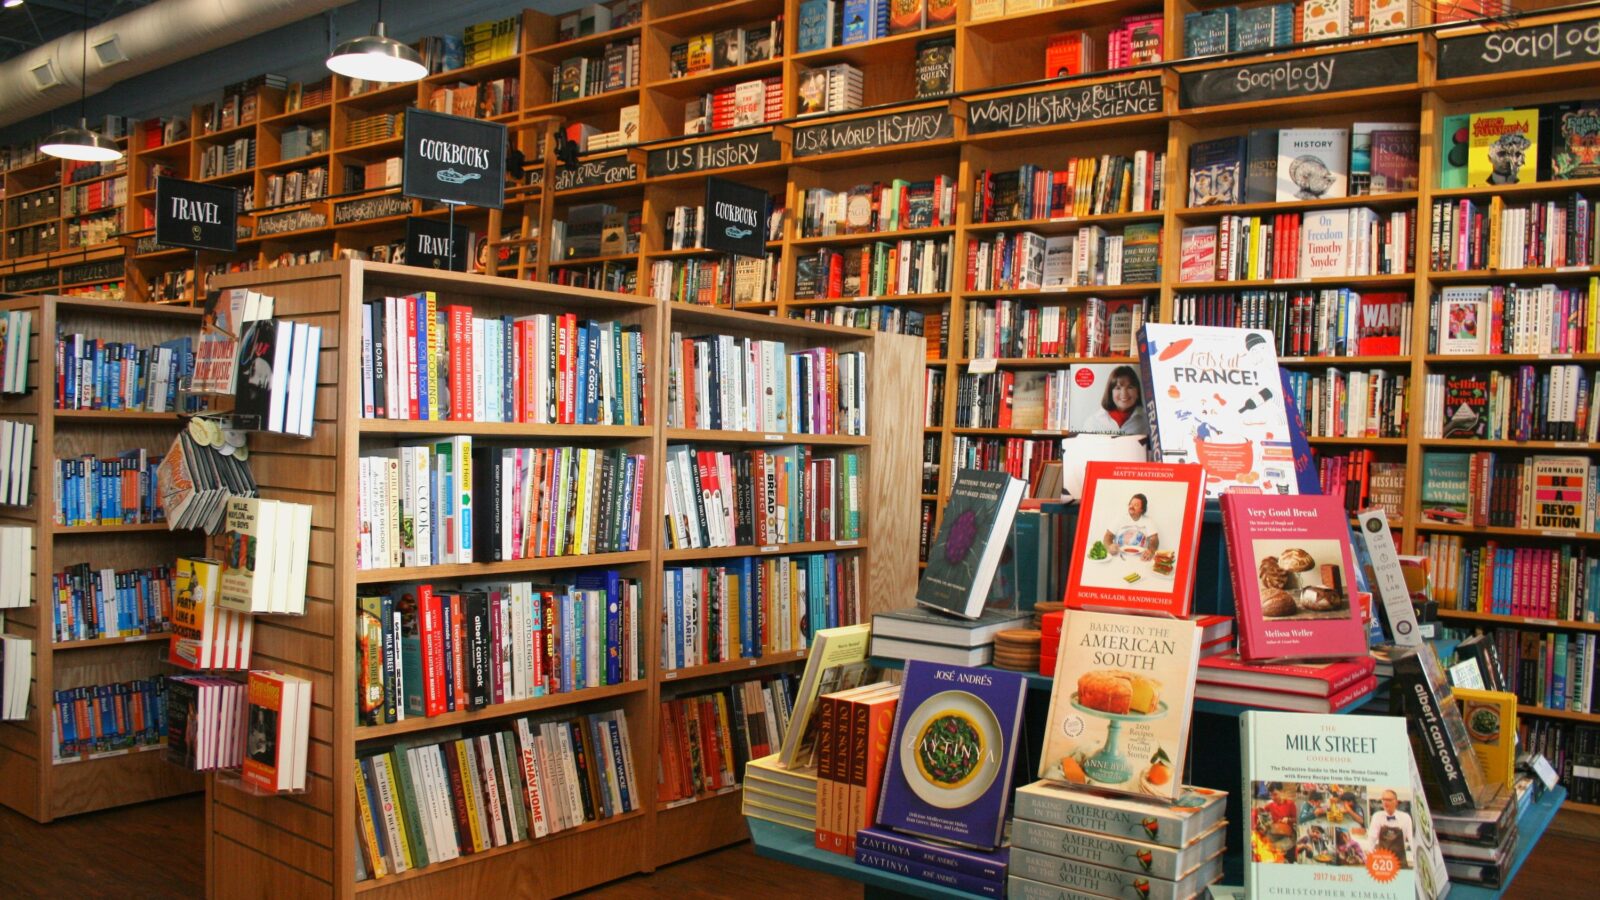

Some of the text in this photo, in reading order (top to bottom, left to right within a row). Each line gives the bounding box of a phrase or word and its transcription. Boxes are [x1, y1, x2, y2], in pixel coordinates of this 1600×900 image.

[921, 63, 949, 73] HEMLOCK
[921, 70, 947, 82] QUEEN
[971, 101, 1023, 127] WORLD
[1081, 91, 1092, 112] &
[819, 128, 829, 148] &
[832, 126, 875, 146] WORLD
[1294, 140, 1333, 148] HISTORY
[420, 138, 490, 170] COOKBOOKS
[667, 148, 694, 171] U.S.
[576, 167, 584, 184] &
[171, 196, 221, 225] TRAVEL
[715, 201, 758, 228] COOKBOOKS
[1319, 215, 1332, 226] On
[1308, 228, 1343, 240] Freedom
[418, 234, 456, 258] TRAVEL
[1308, 239, 1342, 256] Timothy
[1310, 256, 1338, 268] Snyder
[1362, 304, 1400, 328] WAR
[427, 300, 436, 405] BRIGHT COOKING
[212, 361, 232, 380] MUSIC
[588, 339, 597, 404] TIFFY COOKS
[1174, 366, 1259, 386] FRANCE!
[1448, 378, 1486, 391] Selling
[1446, 396, 1486, 406] Dream
[1113, 470, 1175, 479] MATTY MATHESON
[1428, 468, 1466, 478] Women
[1537, 466, 1562, 474] IJEOMA
[1372, 476, 1404, 488] MESSAGE
[1428, 480, 1466, 490] Behind
[955, 490, 998, 500] PLANT-BASED COOKING
[418, 485, 429, 534] COOK
[1248, 508, 1318, 519] Very Good Bread
[1542, 504, 1576, 516] REVO
[1536, 516, 1580, 528] LUTION
[176, 598, 196, 610] PARTY
[1078, 592, 1173, 606] SOUPS, SALADS, SANDWICHES
[175, 612, 188, 622] LIKE
[474, 616, 483, 644] albert
[1089, 622, 1170, 638] BAKING IN THE
[1264, 629, 1314, 638] Melissa Weller
[1080, 633, 1176, 655] AMERICAN
[1093, 651, 1156, 671] SOUTH
[476, 664, 484, 687] cook
[934, 667, 992, 687] JOSÉ ANDRÉS
[822, 703, 832, 729] OUR
[840, 706, 848, 732] OUR
[857, 708, 866, 736] OUR
[1414, 683, 1459, 781] albert can cook
[820, 732, 831, 774] SOUTH
[907, 735, 994, 764] ZAYTINYA
[1286, 734, 1378, 754] MILK STREET
[838, 735, 848, 777] SOUTH
[854, 737, 865, 780] SOUTH
[524, 749, 543, 823] ZAHAV HOME
[1312, 774, 1330, 782] Recipe
[1066, 816, 1107, 831] SOUTH
[1067, 804, 1130, 824] AMERICAN
[862, 837, 959, 868] ZAYTINYA JOSÉ ANDRÉS
[1061, 844, 1102, 861] SOUTH
[1062, 832, 1125, 854] AMERICAN
[860, 853, 958, 884] ZAYTINYA JOSÉ ANDRÉS
[1060, 862, 1122, 884] AMERICAN
[1372, 860, 1393, 872] 620
[1058, 874, 1098, 890] SOUTH
[1314, 872, 1353, 882] 2017 to 2025
[1269, 887, 1398, 900] CHRISTOPHER KIMBALL
